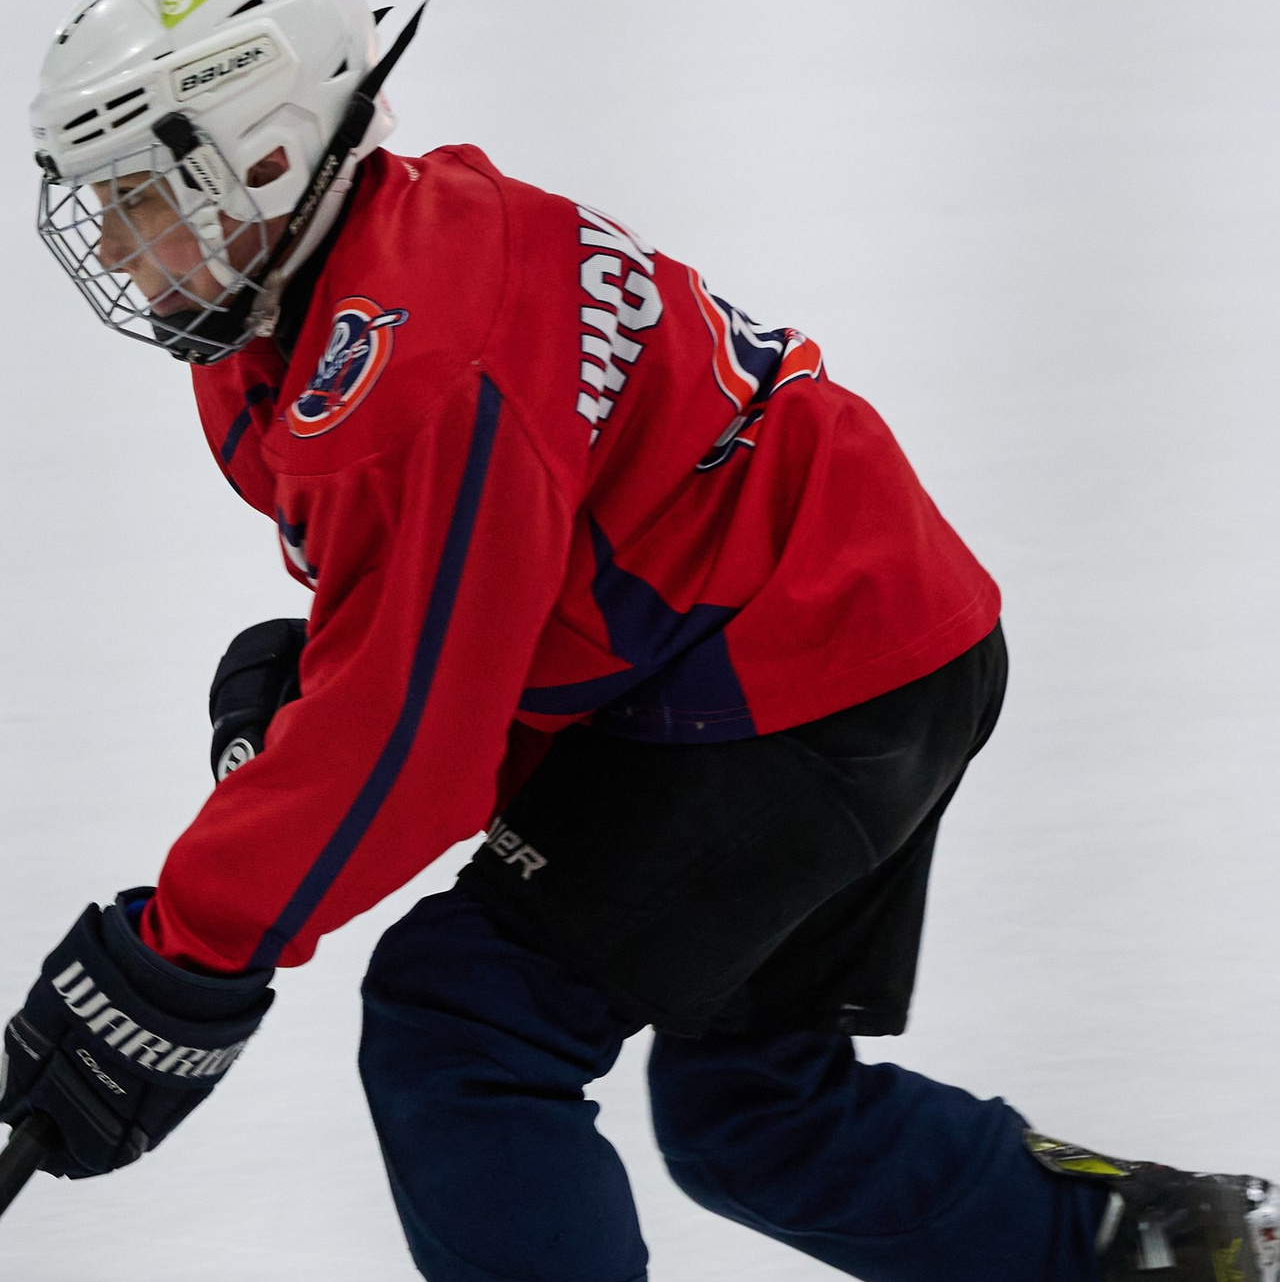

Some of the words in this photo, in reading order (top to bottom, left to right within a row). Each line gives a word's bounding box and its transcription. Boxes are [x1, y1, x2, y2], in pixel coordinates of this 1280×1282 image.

[486, 817, 548, 881] UER
[51, 960, 248, 1078] WARRIO
[76, 1049, 127, 1095] COVERT
